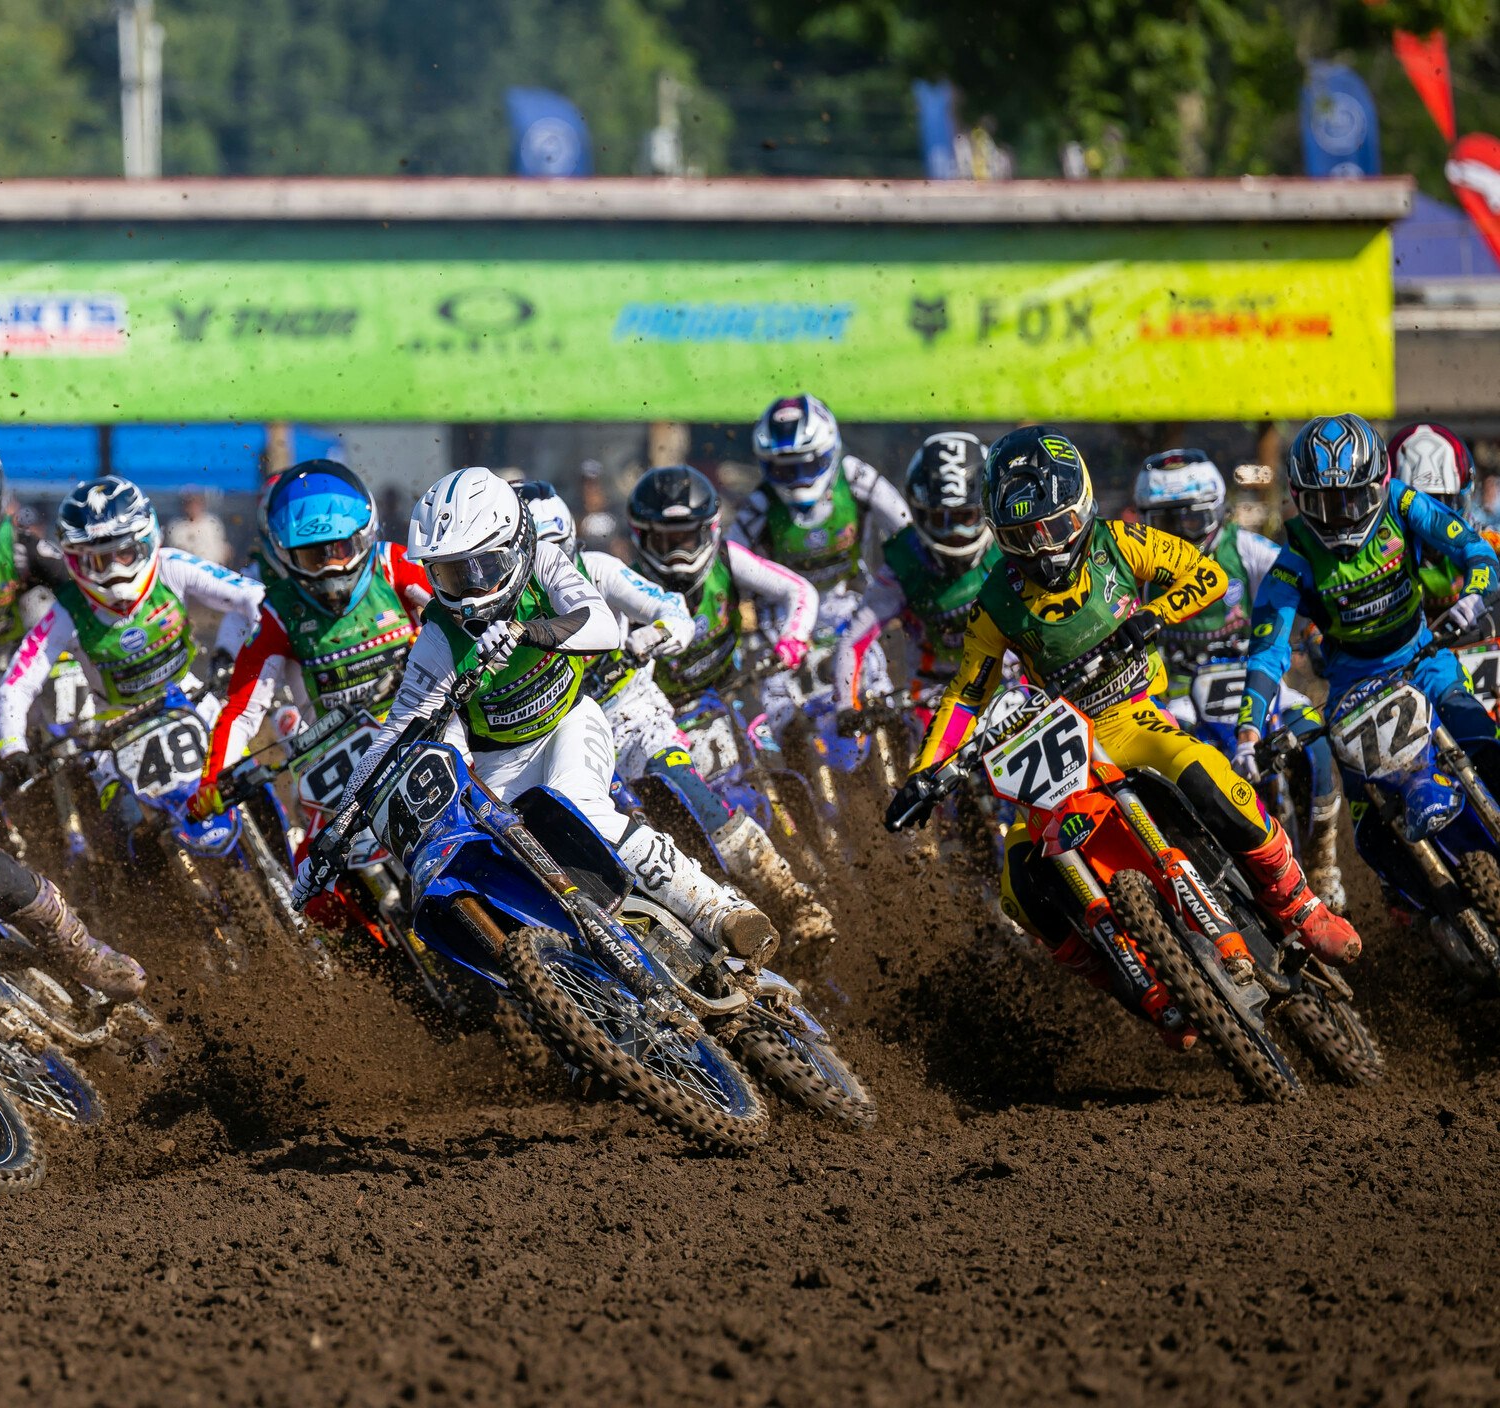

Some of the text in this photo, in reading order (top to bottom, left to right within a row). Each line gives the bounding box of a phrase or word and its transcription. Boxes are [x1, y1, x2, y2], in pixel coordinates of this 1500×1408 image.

[977, 297, 1093, 345] FOX
[137, 724, 206, 790] 48
[1007, 713, 1087, 806] 26
[1341, 694, 1430, 777] 72
[1048, 776, 1080, 802] THROTTLE
[583, 917, 638, 971] DUNLOP
[1099, 918, 1150, 990] DUNLOP
